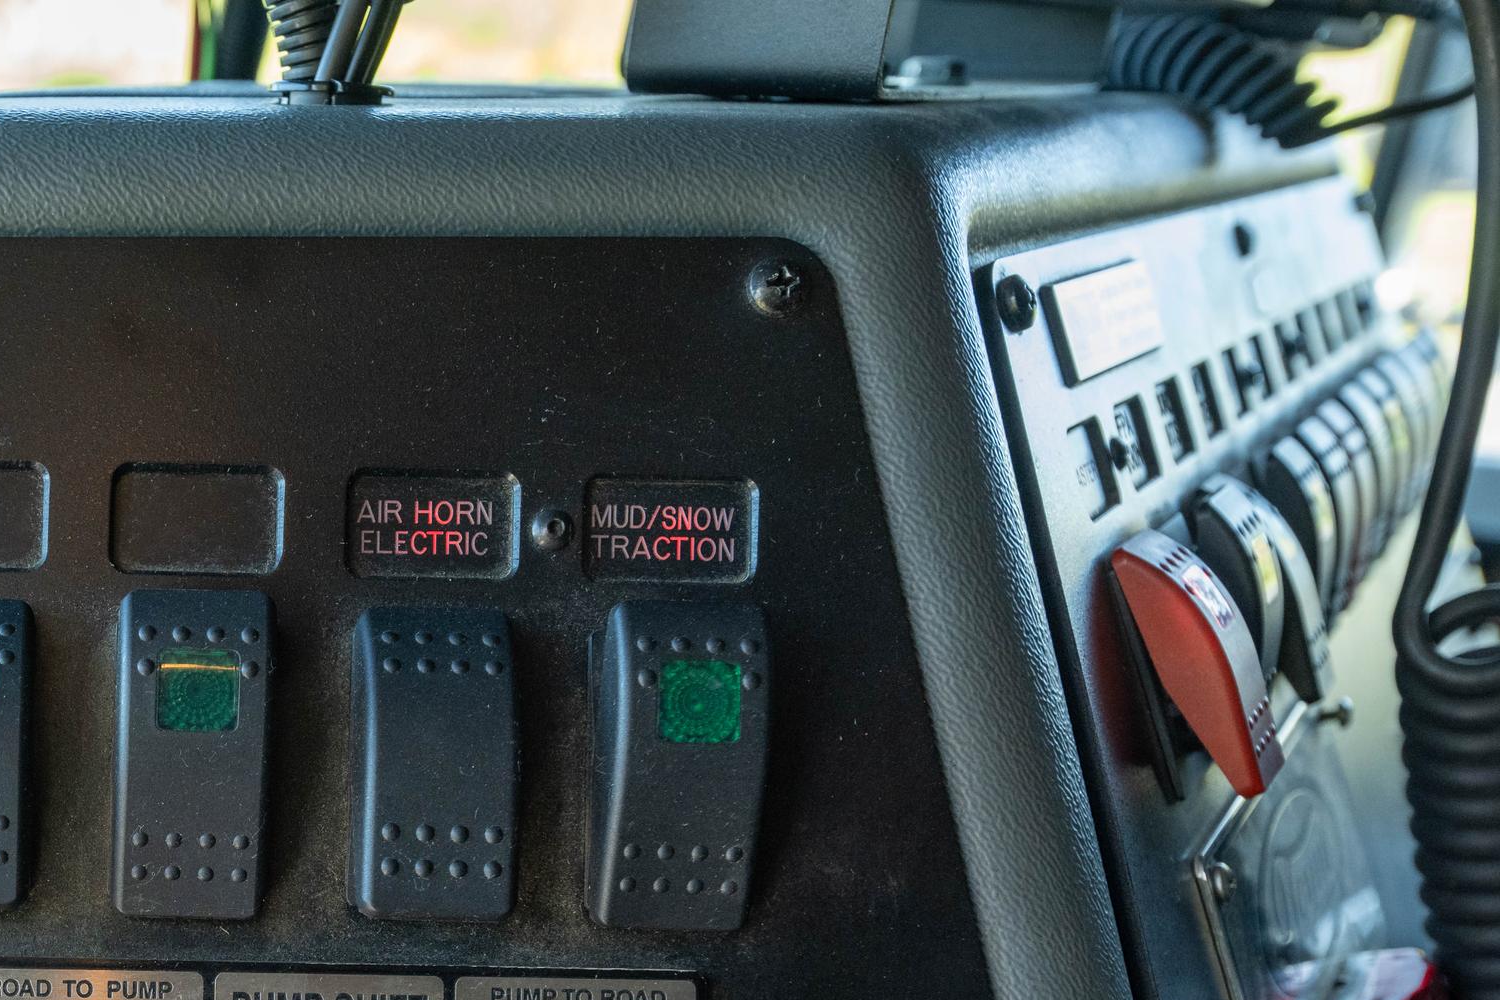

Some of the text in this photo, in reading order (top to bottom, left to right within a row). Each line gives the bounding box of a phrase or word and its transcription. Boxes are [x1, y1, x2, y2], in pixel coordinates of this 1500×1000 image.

[356, 499, 494, 526] AIR HORN
[591, 504, 735, 532] MUD/SNOW
[360, 530, 489, 556] ELECTRIC
[591, 535, 735, 563] TRACTION
[62, 979, 94, 998] TO
[107, 980, 174, 1000] PUMP
